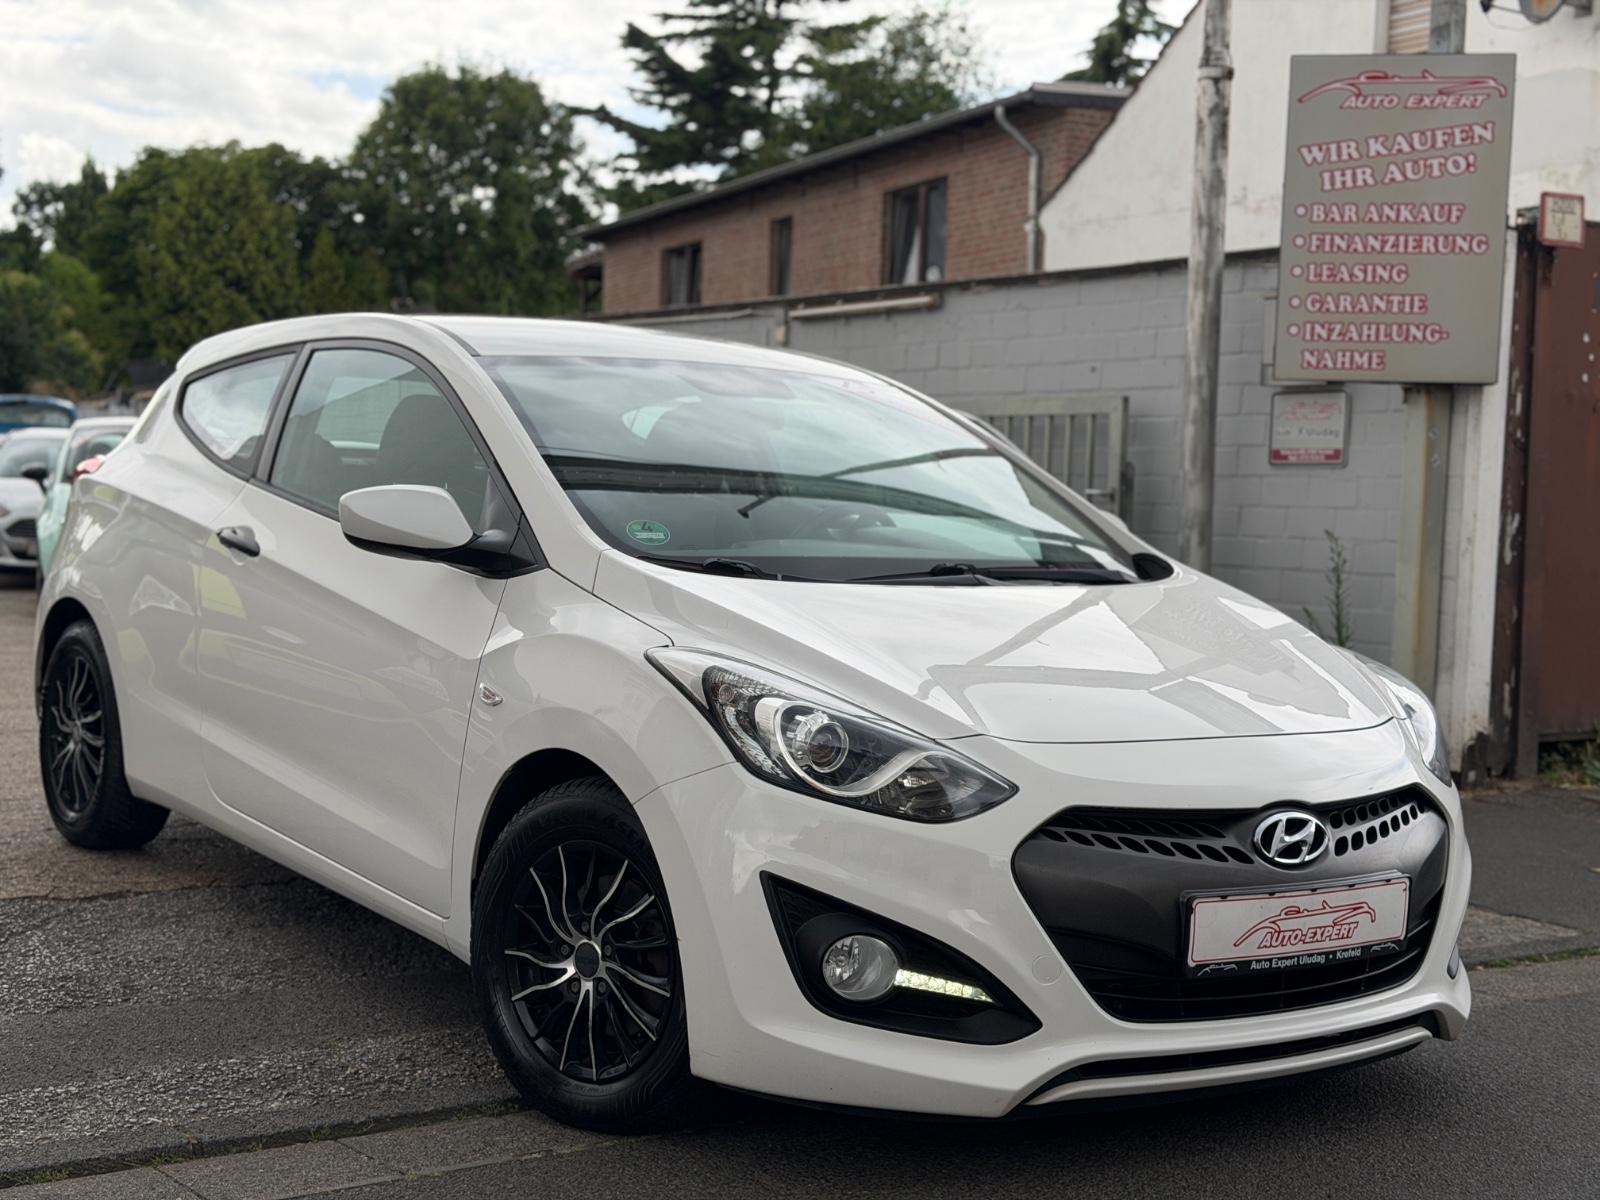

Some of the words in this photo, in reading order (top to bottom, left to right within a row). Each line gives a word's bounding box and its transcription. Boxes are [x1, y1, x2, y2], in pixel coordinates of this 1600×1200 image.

[1340, 94, 1398, 109] AUTO
[1404, 94, 1490, 109] EXPERT
[1299, 140, 1361, 166] WIR
[1366, 121, 1496, 158] KAUFEN
[1321, 166, 1376, 192] IHR
[1382, 153, 1477, 184] AUTO!
[1309, 204, 1359, 223] BAR
[1363, 203, 1466, 224] ANKAUF
[1308, 232, 1489, 254] FINANZIERUNG
[1306, 263, 1409, 283] LEASING
[1304, 294, 1428, 314] GARANTIE
[1301, 350, 1386, 370] NAHME
[1257, 921, 1359, 949] AUTO-EXPERT
[1250, 960, 1270, 970] Auto
[1271, 958, 1298, 968] Expert
[1299, 954, 1326, 965] Uludag
[1336, 948, 1362, 960] Krefeld
